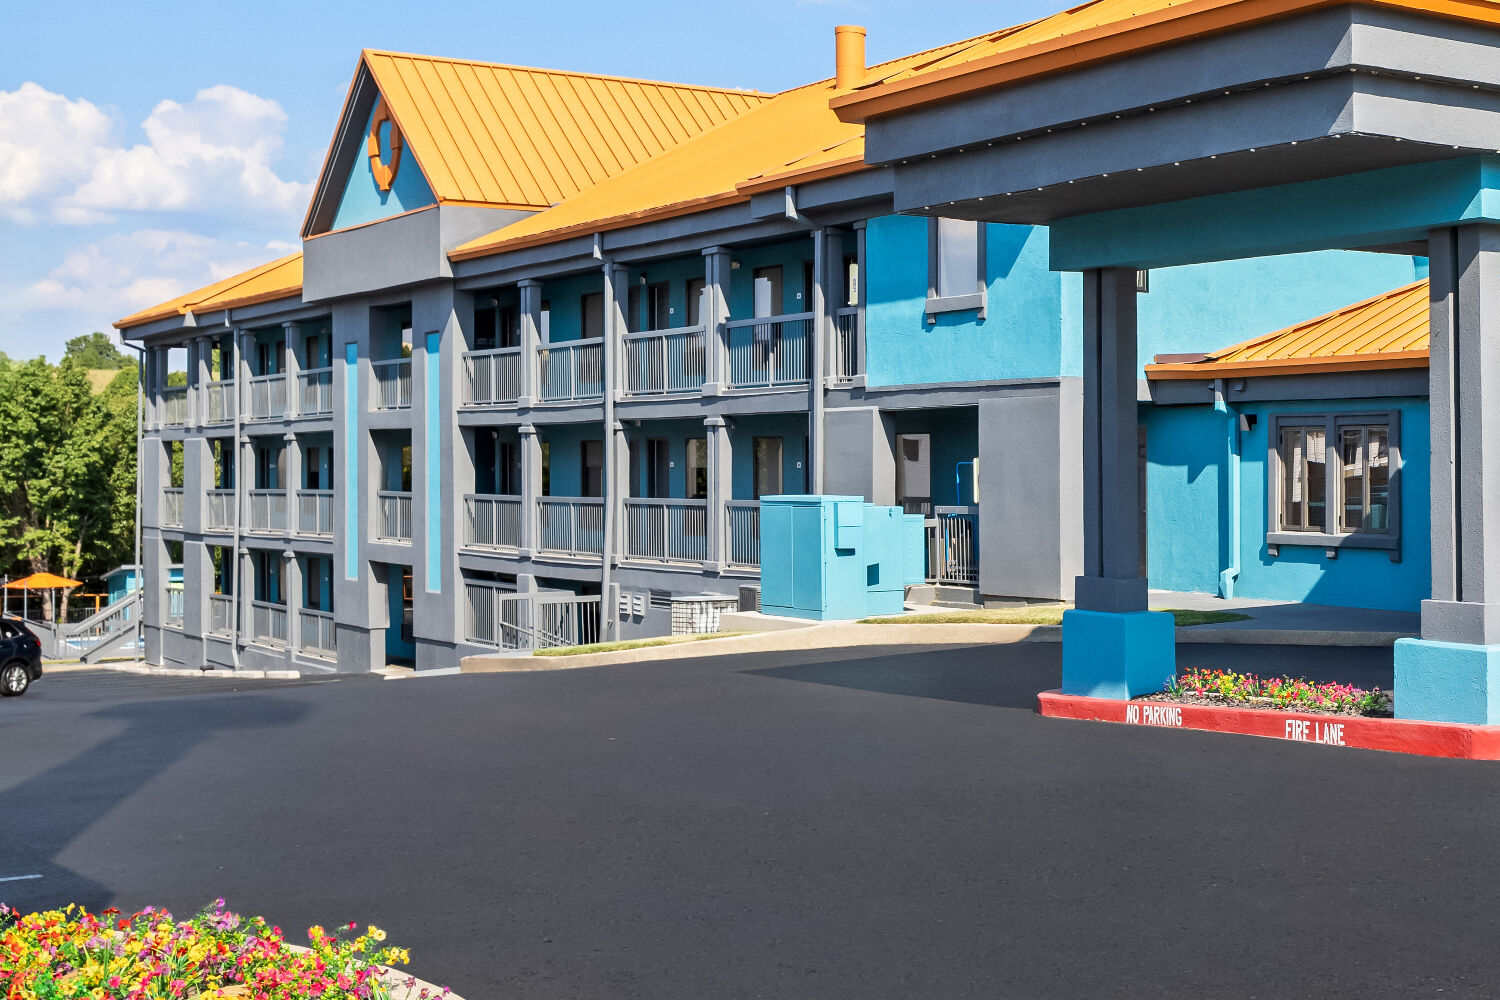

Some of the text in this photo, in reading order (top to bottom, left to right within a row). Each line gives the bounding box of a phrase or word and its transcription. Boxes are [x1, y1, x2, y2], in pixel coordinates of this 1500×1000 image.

[1126, 704, 1183, 726] NO PARKING
[1285, 719, 1346, 746] FIRE LANE
